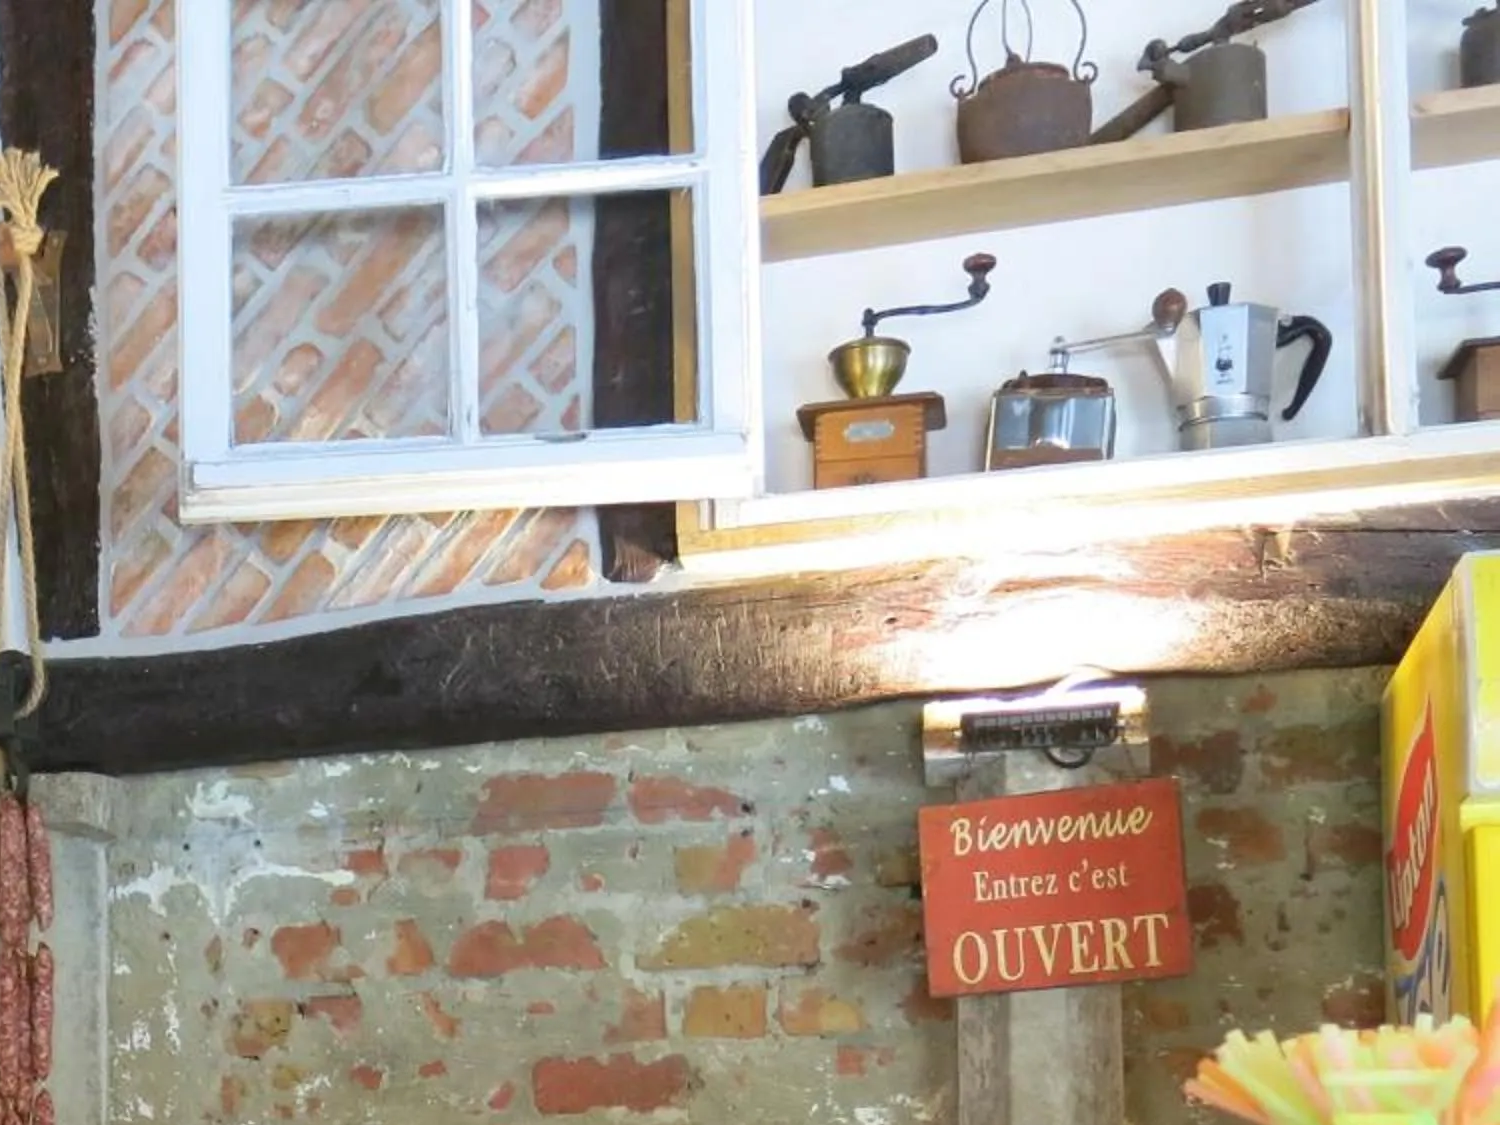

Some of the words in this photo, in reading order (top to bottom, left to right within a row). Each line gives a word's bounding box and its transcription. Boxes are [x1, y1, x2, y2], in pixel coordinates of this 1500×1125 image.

[950, 805, 1154, 856] Bienvenue
[1390, 757, 1435, 930] Lipton
[972, 870, 1059, 902] Entrez
[1068, 858, 1130, 893] c'est
[952, 912, 1170, 985] OUVERT
